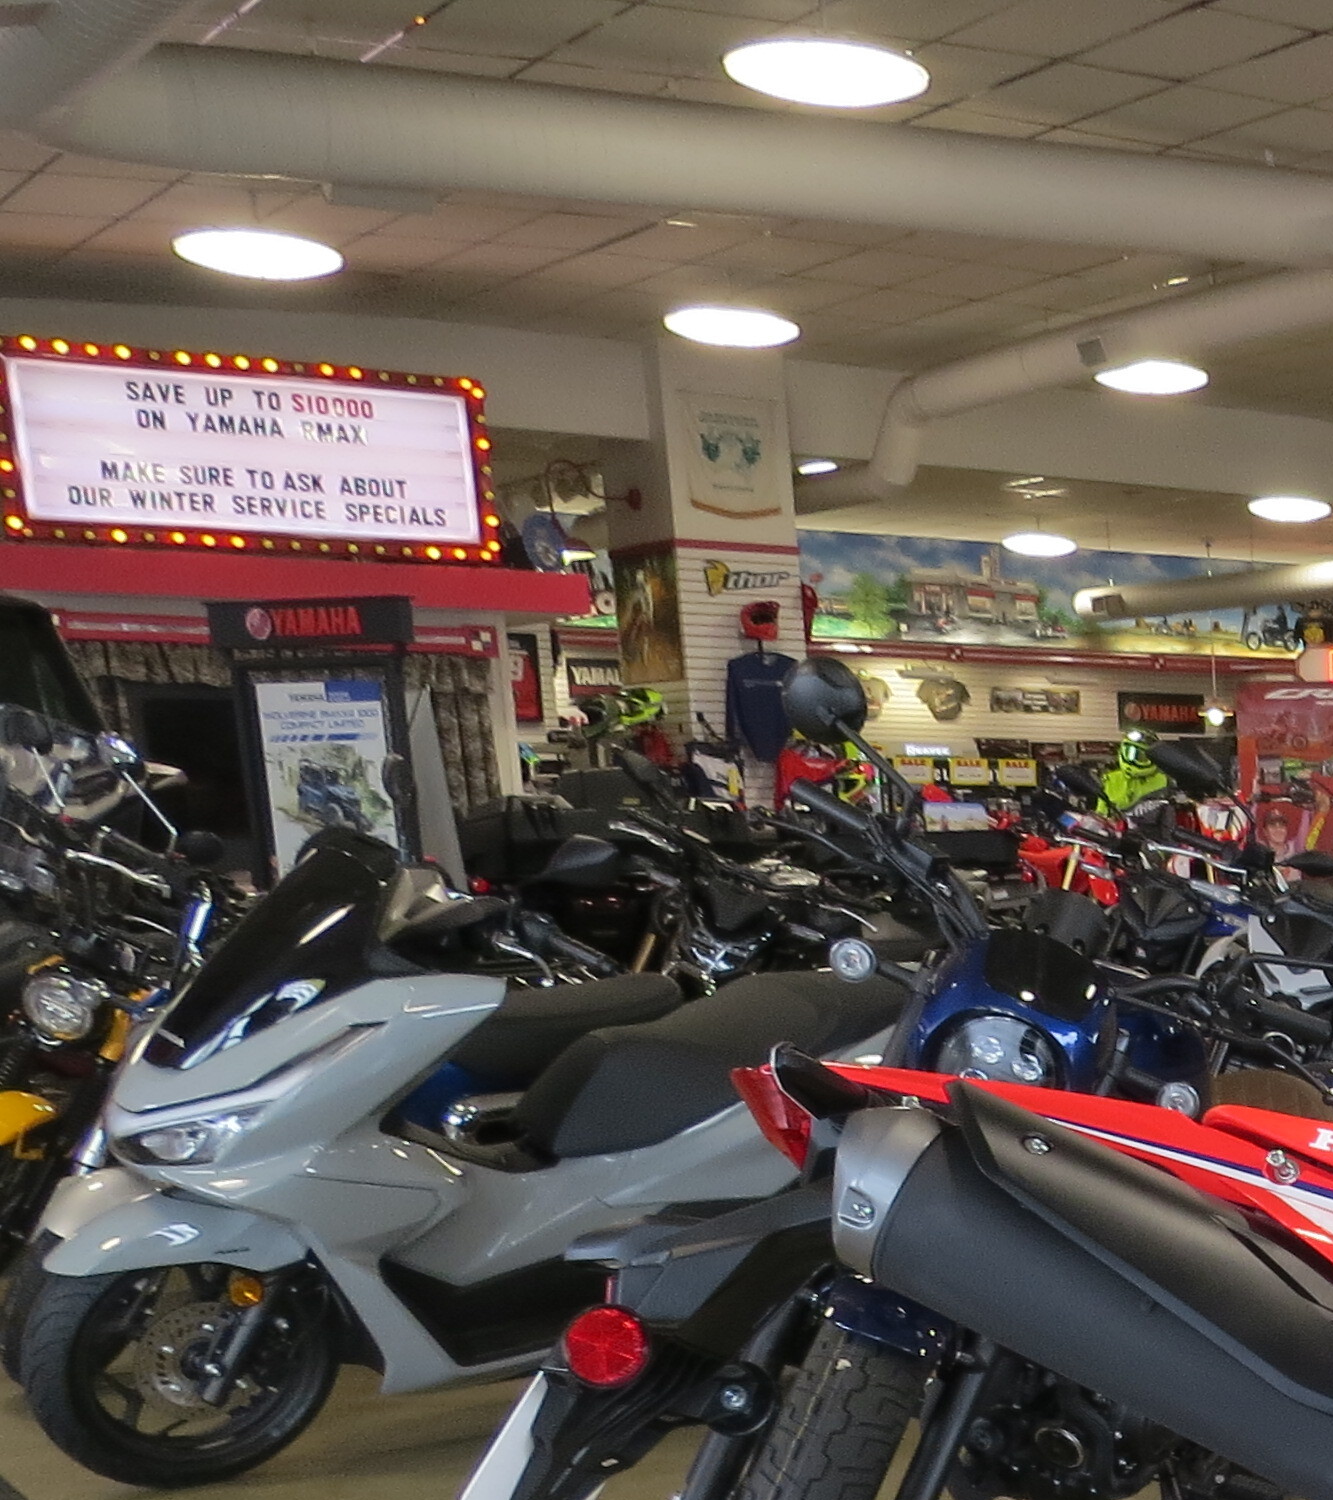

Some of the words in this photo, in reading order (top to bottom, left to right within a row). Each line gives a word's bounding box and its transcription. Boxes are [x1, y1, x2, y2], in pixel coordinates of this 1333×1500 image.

[125, 381, 187, 405] SAVE
[204, 386, 234, 407] UP
[253, 389, 282, 411] TO
[135, 408, 167, 430] ON
[186, 411, 285, 438] YAMAHA
[301, 420, 368, 446] RMAX
[100, 460, 166, 483] MAKE
[179, 465, 235, 488] SURE
[245, 468, 274, 490] TO
[283, 471, 326, 494] ASK
[339, 475, 407, 499] ABOUT
[67, 484, 112, 507] OUR
[128, 488, 217, 512] WINTER
[232, 494, 327, 520] SERVICE
[344, 502, 448, 527] SPECIALS
[270, 605, 364, 637] YAMAHA
